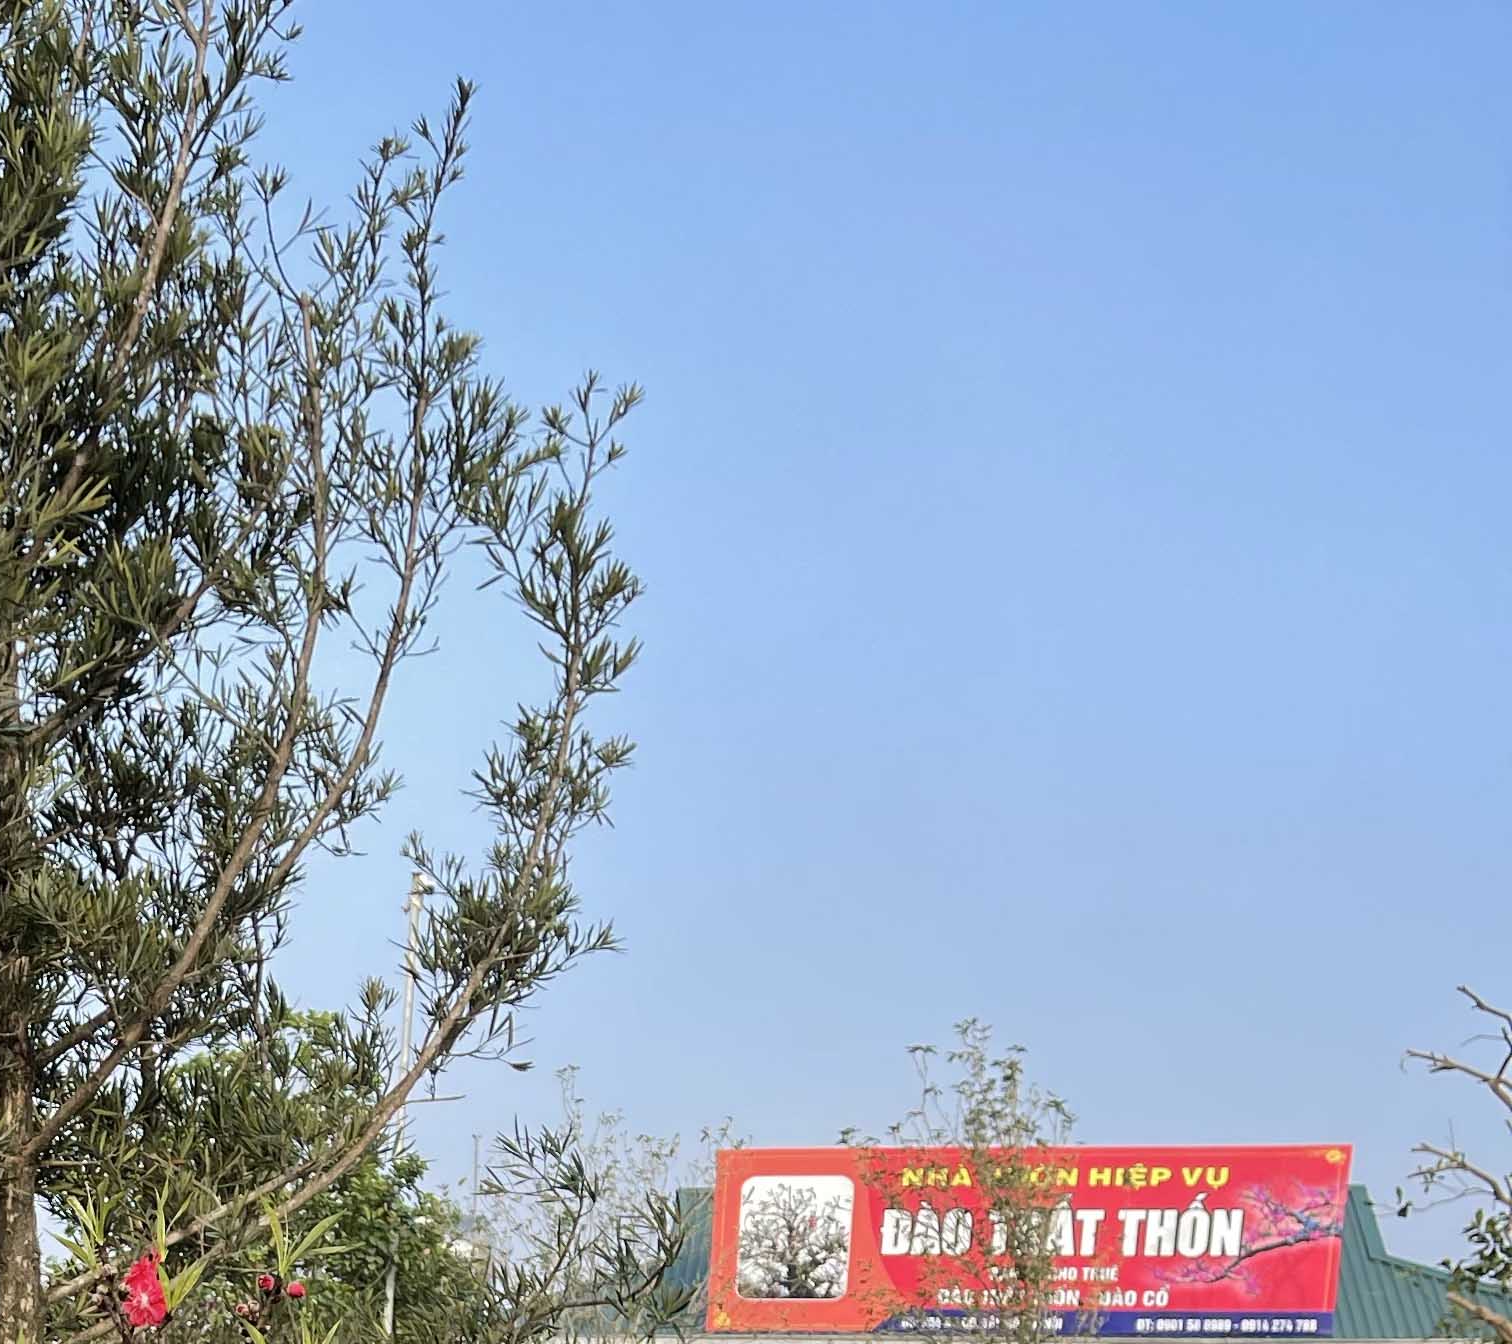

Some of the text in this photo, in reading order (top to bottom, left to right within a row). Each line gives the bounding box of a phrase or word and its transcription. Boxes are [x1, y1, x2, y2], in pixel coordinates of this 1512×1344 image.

[901, 1163, 973, 1187] NHÀ
[1182, 1166, 1230, 1190] VỤ
[880, 1200, 974, 1257] ĐÀO
[1118, 1191, 1245, 1258] THỐN
[1141, 1283, 1170, 1307] CỔ
